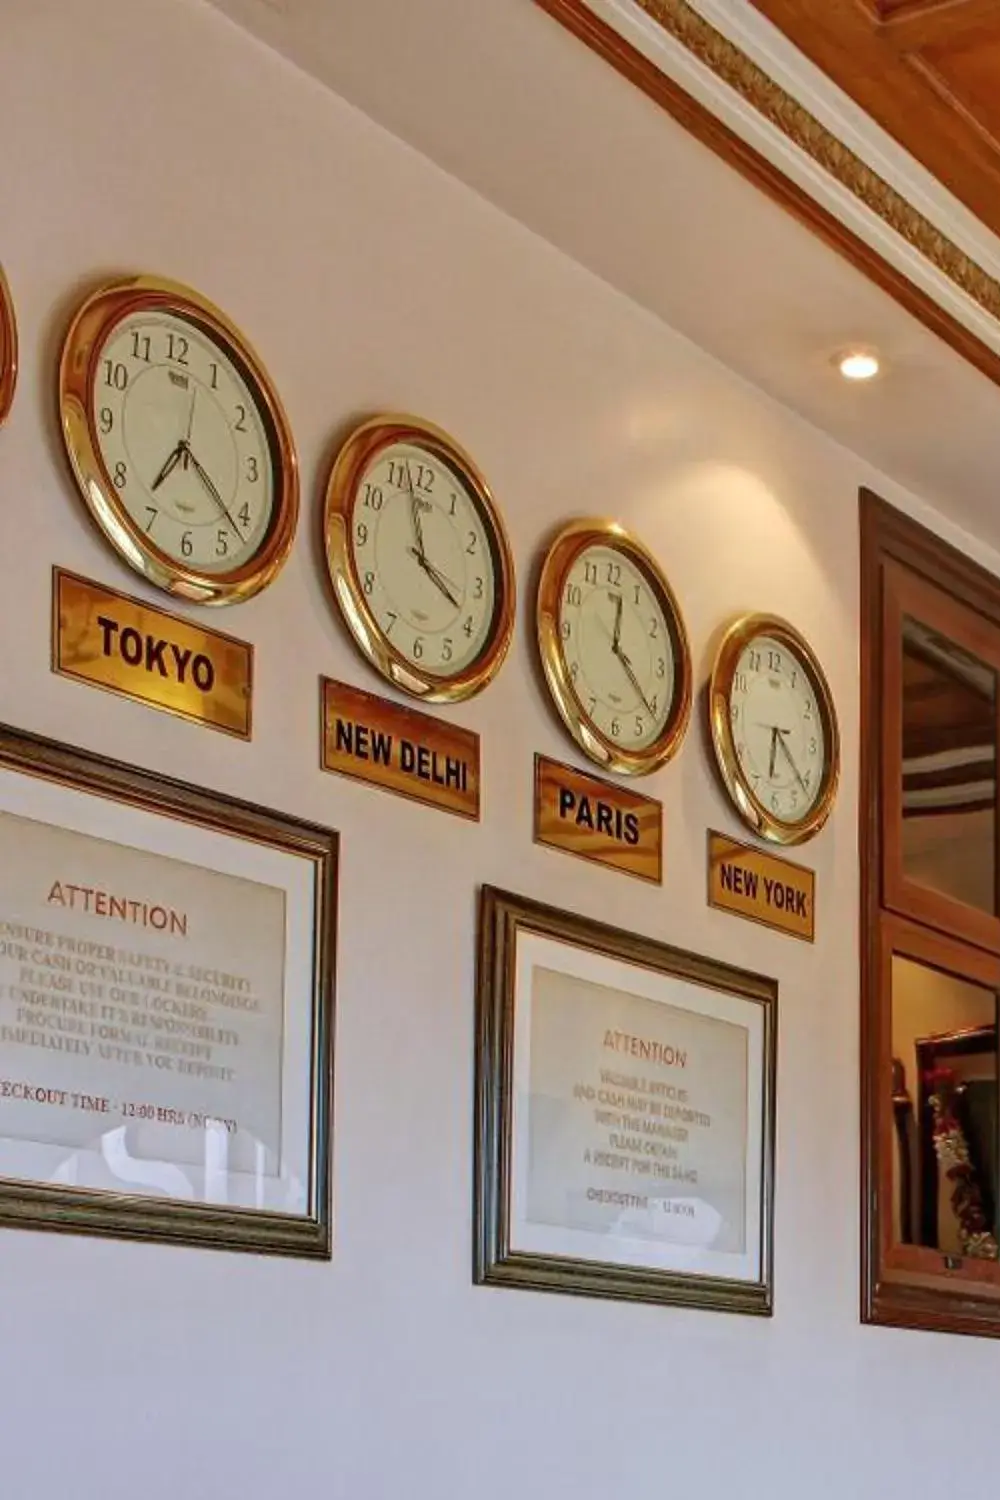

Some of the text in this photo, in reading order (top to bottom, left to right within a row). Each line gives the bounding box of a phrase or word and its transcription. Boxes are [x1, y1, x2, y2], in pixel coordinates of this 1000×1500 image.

[131, 331, 151, 362] 11
[165, 333, 189, 365] 12
[103, 359, 128, 391] 10
[209, 363, 218, 390] 1
[100, 407, 113, 434] 9
[234, 405, 247, 433] 2
[113, 461, 127, 489] 8
[246, 456, 259, 483] 3
[386, 461, 405, 489] 11
[415, 465, 435, 493] 12
[363, 483, 383, 511] 10
[448, 493, 457, 516] 1
[144, 505, 158, 532] 7
[237, 502, 251, 527] 4
[180, 531, 193, 557] 6
[215, 529, 228, 556] 5
[356, 522, 368, 547] 9
[466, 531, 477, 555] 2
[363, 571, 375, 594] 8
[584, 561, 597, 586] 11
[607, 562, 621, 588] 12
[473, 577, 483, 600] 3
[567, 583, 581, 608] 10
[633, 585, 641, 605] 1
[386, 611, 397, 634] 7
[463, 615, 473, 638] 4
[561, 620, 571, 641] 9
[649, 618, 658, 639] 2
[98, 616, 215, 692] TOKYO
[413, 636, 424, 659] 6
[441, 637, 453, 661] 5
[656, 657, 665, 679] 3
[589, 697, 597, 718] 7
[611, 716, 620, 737] 6
[634, 716, 643, 737] 5
[335, 718, 468, 793] NEW DELHI
[558, 789, 640, 846] PARIS
[720, 863, 808, 919] NEW YORK
[47, 880, 188, 936] ATTENTION
[602, 1028, 688, 1069] ATTENTION
[0, 1080, 68, 1105] ECKOUT
[71, 1092, 110, 1113] TIME
